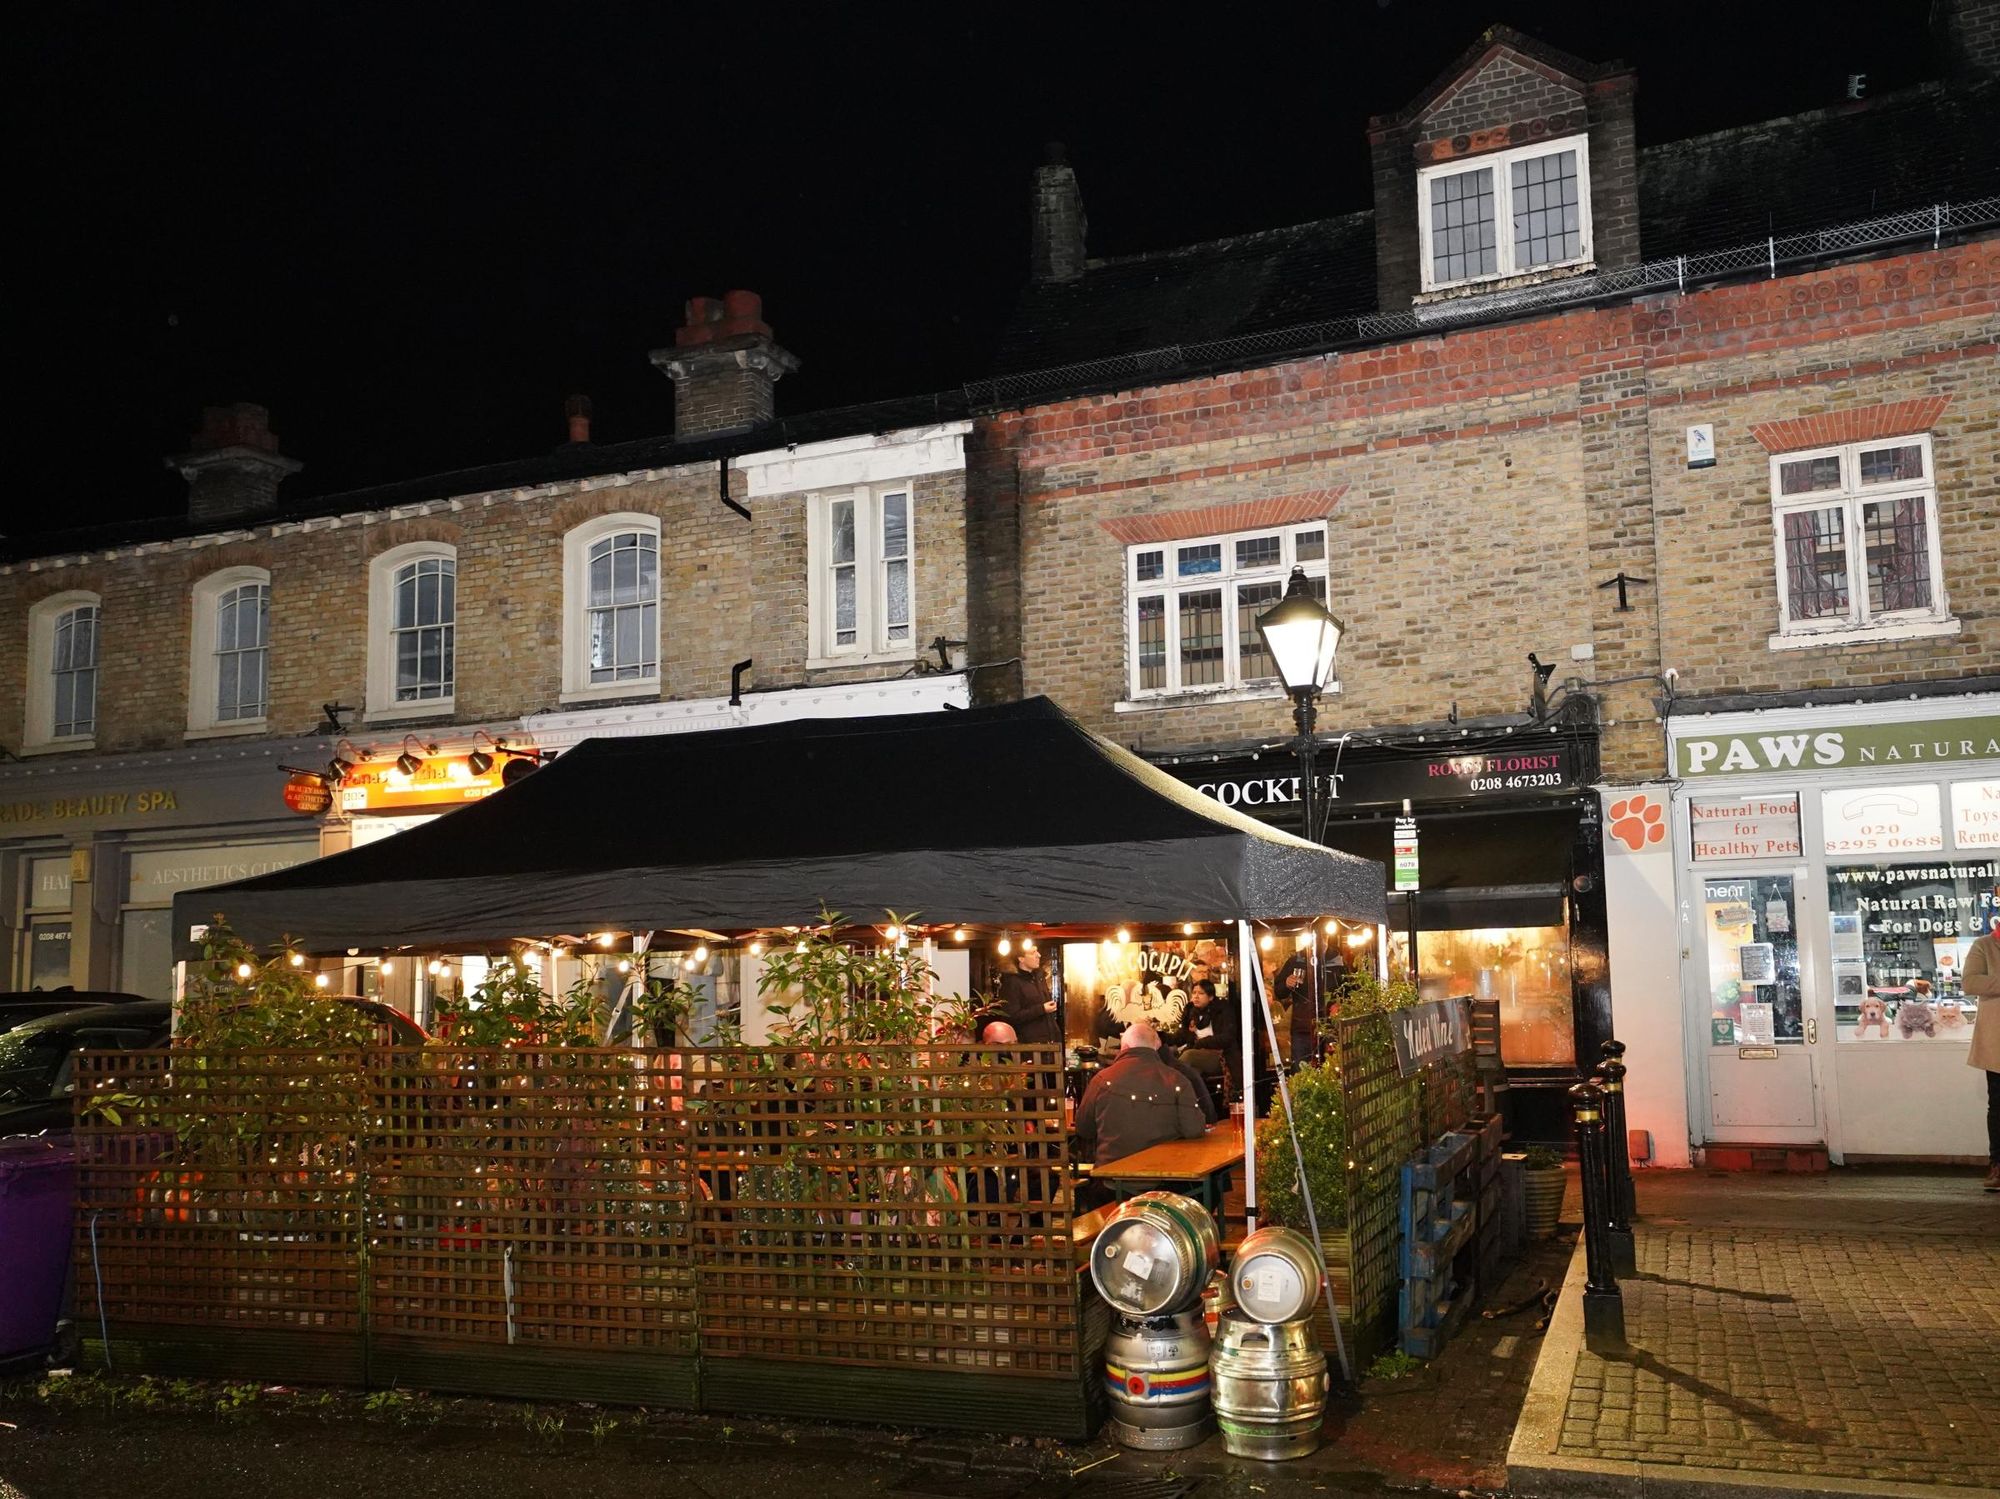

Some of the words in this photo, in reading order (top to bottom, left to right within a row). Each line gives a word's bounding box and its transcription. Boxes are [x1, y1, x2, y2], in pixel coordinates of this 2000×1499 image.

[1686, 732, 1845, 773] PAWS
[1859, 738, 2000, 762] NATURA
[1486, 755, 1560, 773] FLORIST
[1470, 778, 1502, 791] 0208
[1505, 772, 1562, 789] 4673203
[53, 793, 129, 818] BEAUTY
[137, 790, 177, 812] SPA
[1693, 803, 1752, 819] Natural
[1760, 801, 1798, 815] Food
[1962, 808, 2000, 826] Toys
[1734, 822, 1759, 835] for
[1861, 824, 1900, 836] 020
[1696, 842, 1760, 857] Healthy
[1766, 840, 1799, 852] Pets
[1826, 839, 1878, 851] 8295
[1888, 836, 1941, 848] 0688
[153, 863, 247, 884] AESTHETICS
[1836, 863, 2000, 885] www.pawsnaturall
[1857, 896, 1928, 912] Natural
[1933, 894, 1974, 910] Raw
[1881, 918, 1913, 934] For
[1918, 917, 1962, 936] Dogs
[1969, 916, 1983, 931] &
[1127, 950, 1197, 981] COCKPIT
